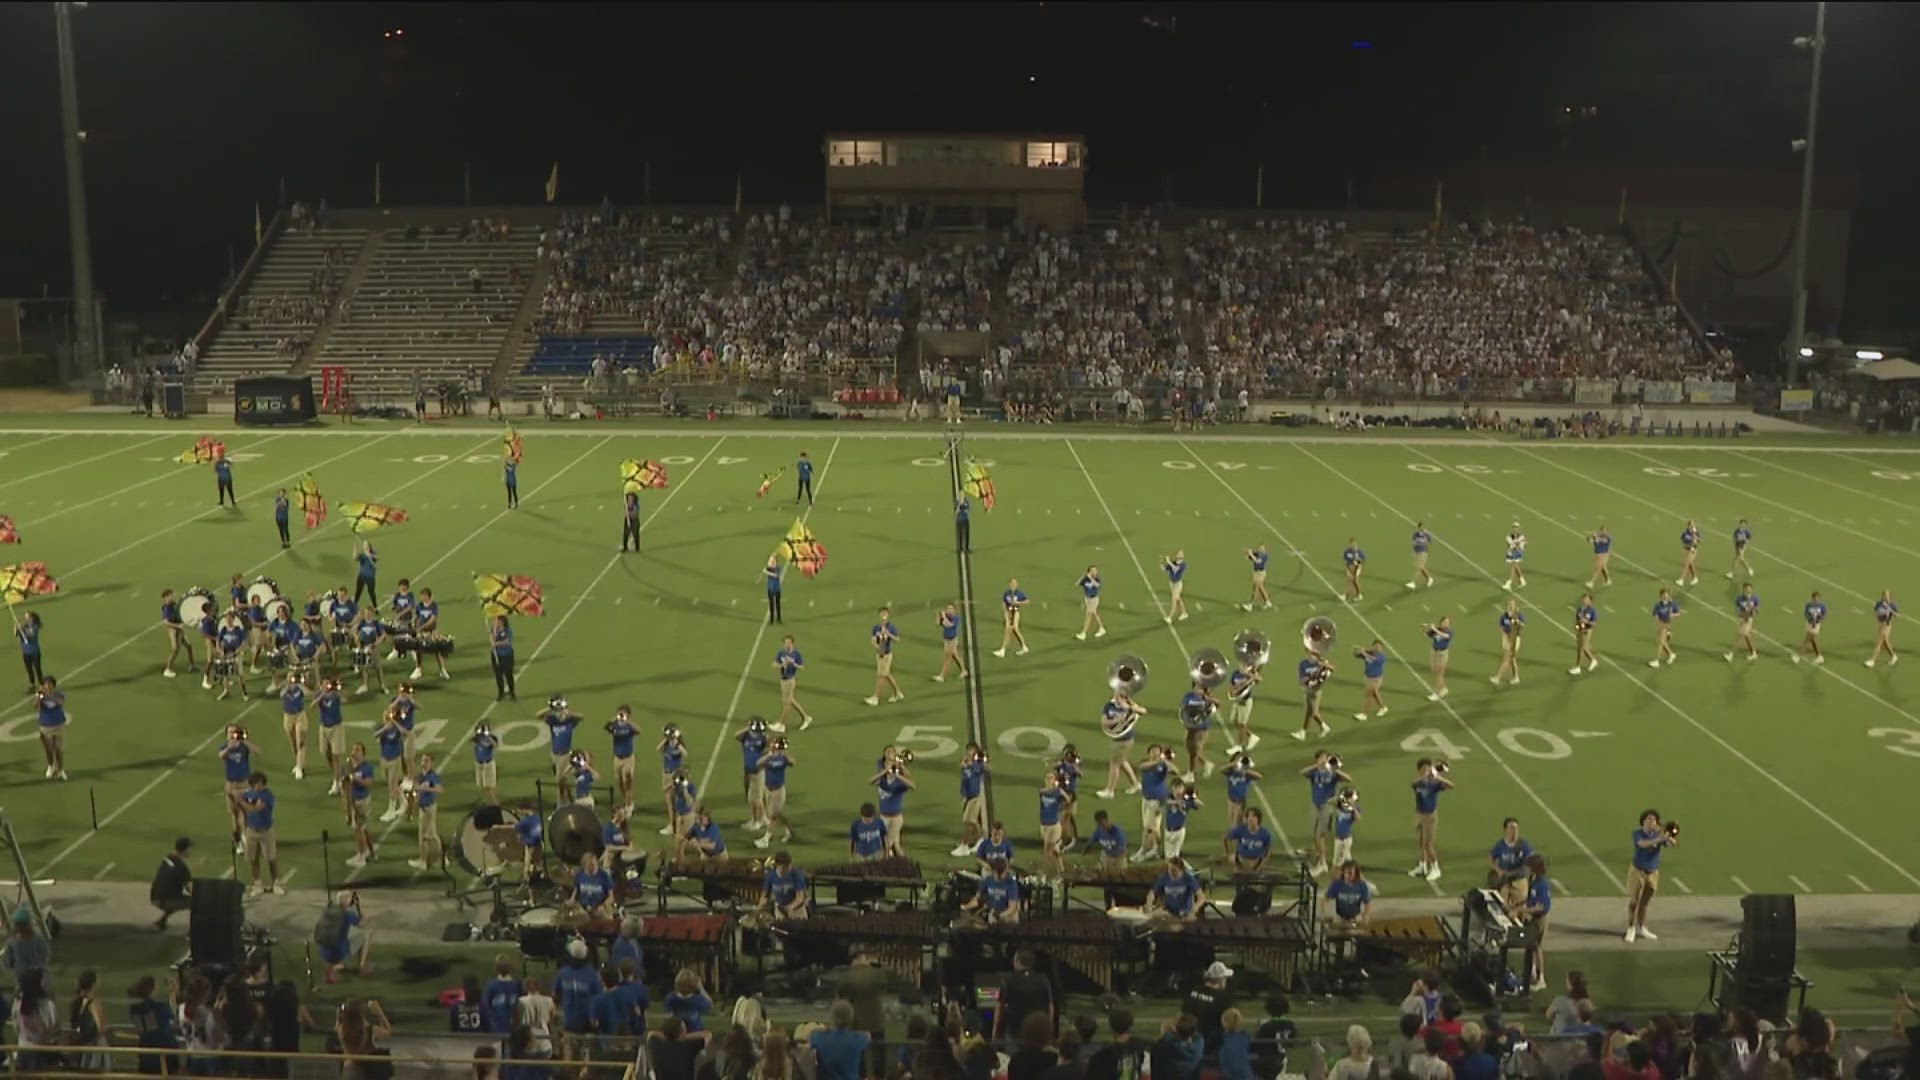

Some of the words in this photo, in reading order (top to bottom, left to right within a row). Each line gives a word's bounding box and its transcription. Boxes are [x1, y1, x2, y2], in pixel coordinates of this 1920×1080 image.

[659, 455, 749, 465] 40
[896, 725, 1067, 759] 50
[1400, 727, 1573, 760] 40
[458, 1013, 480, 1028] 20
